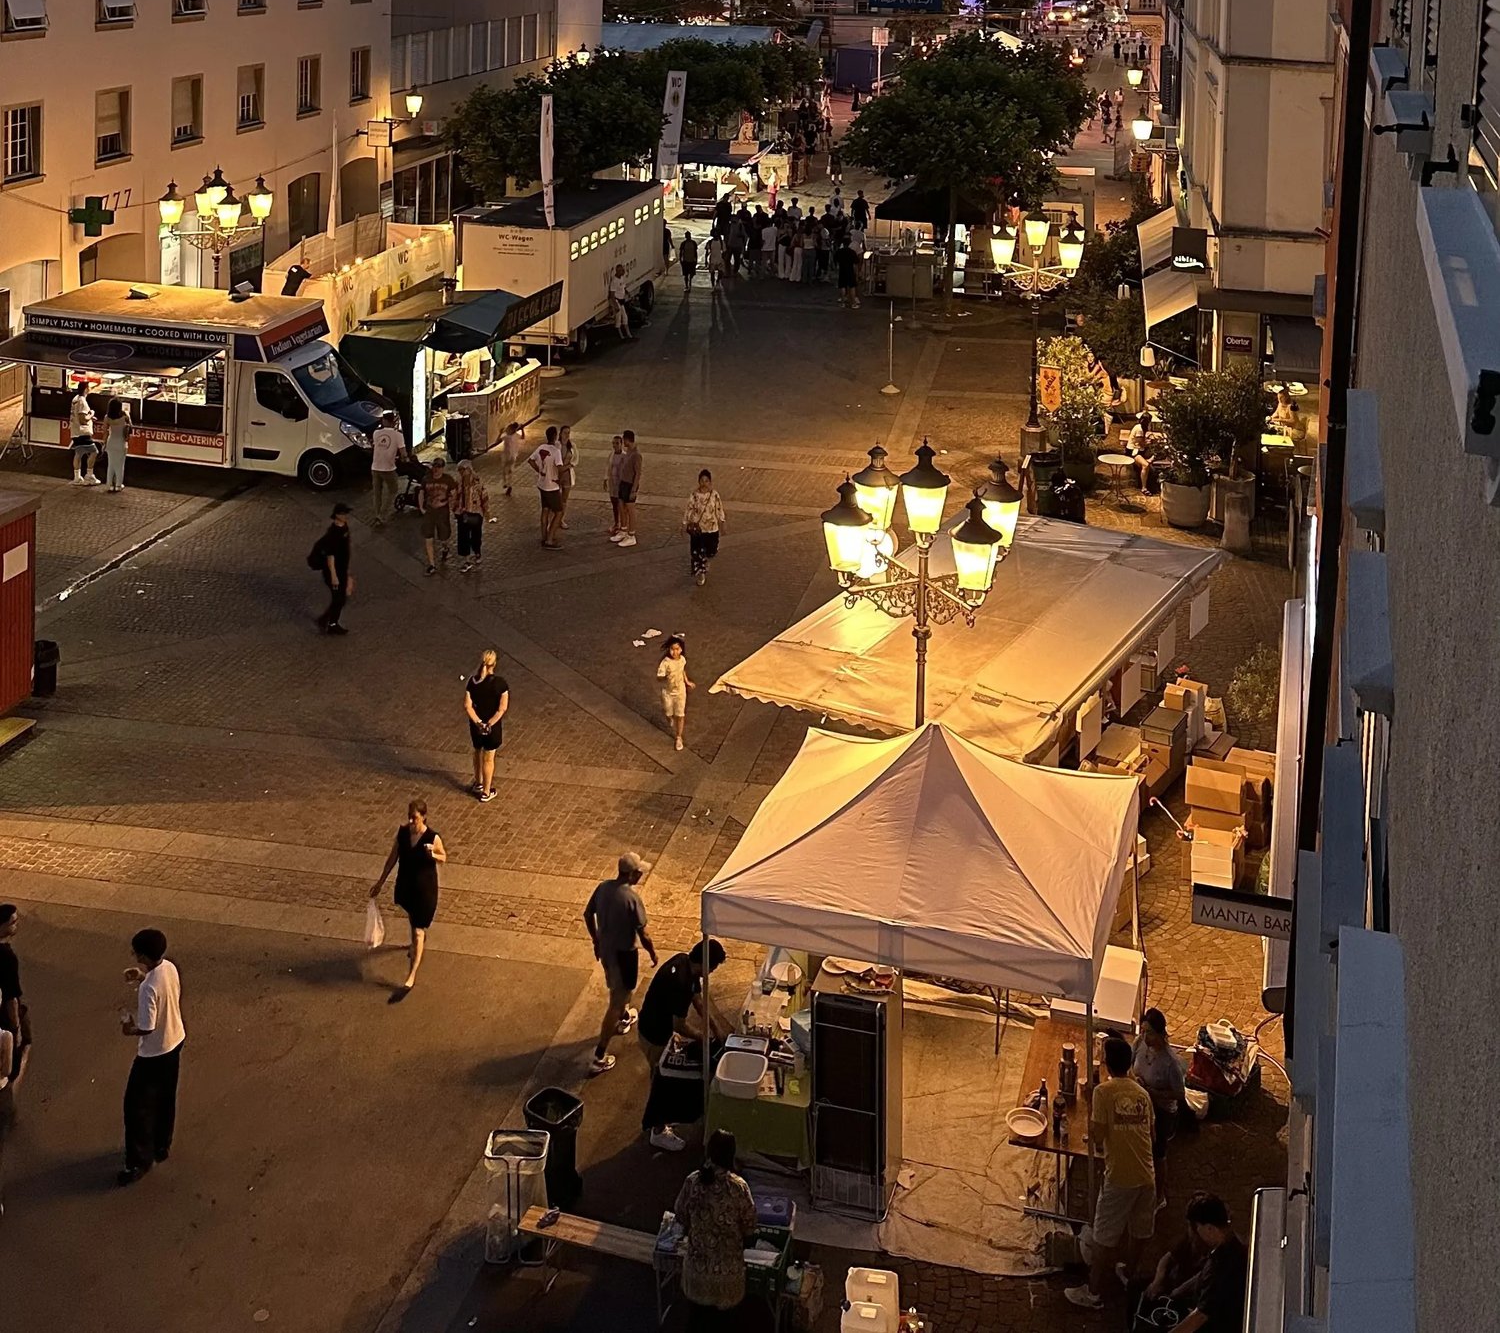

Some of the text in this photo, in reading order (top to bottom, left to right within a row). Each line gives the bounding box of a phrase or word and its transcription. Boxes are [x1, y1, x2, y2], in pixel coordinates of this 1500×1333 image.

[671, 76, 682, 88] WC
[397, 250, 409, 265] WC
[342, 276, 354, 294] WC
[31, 316, 226, 343] SIMPLY TASTY HOMEMADE COOKED WITH LOVE
[270, 324, 324, 356] Indian Vegetarian
[1226, 337, 1251, 346] Obertor
[146, 431, 176, 442] EVENTS
[180, 435, 223, 447] CATERING
[1200, 903, 1292, 934] MANTA BAR
